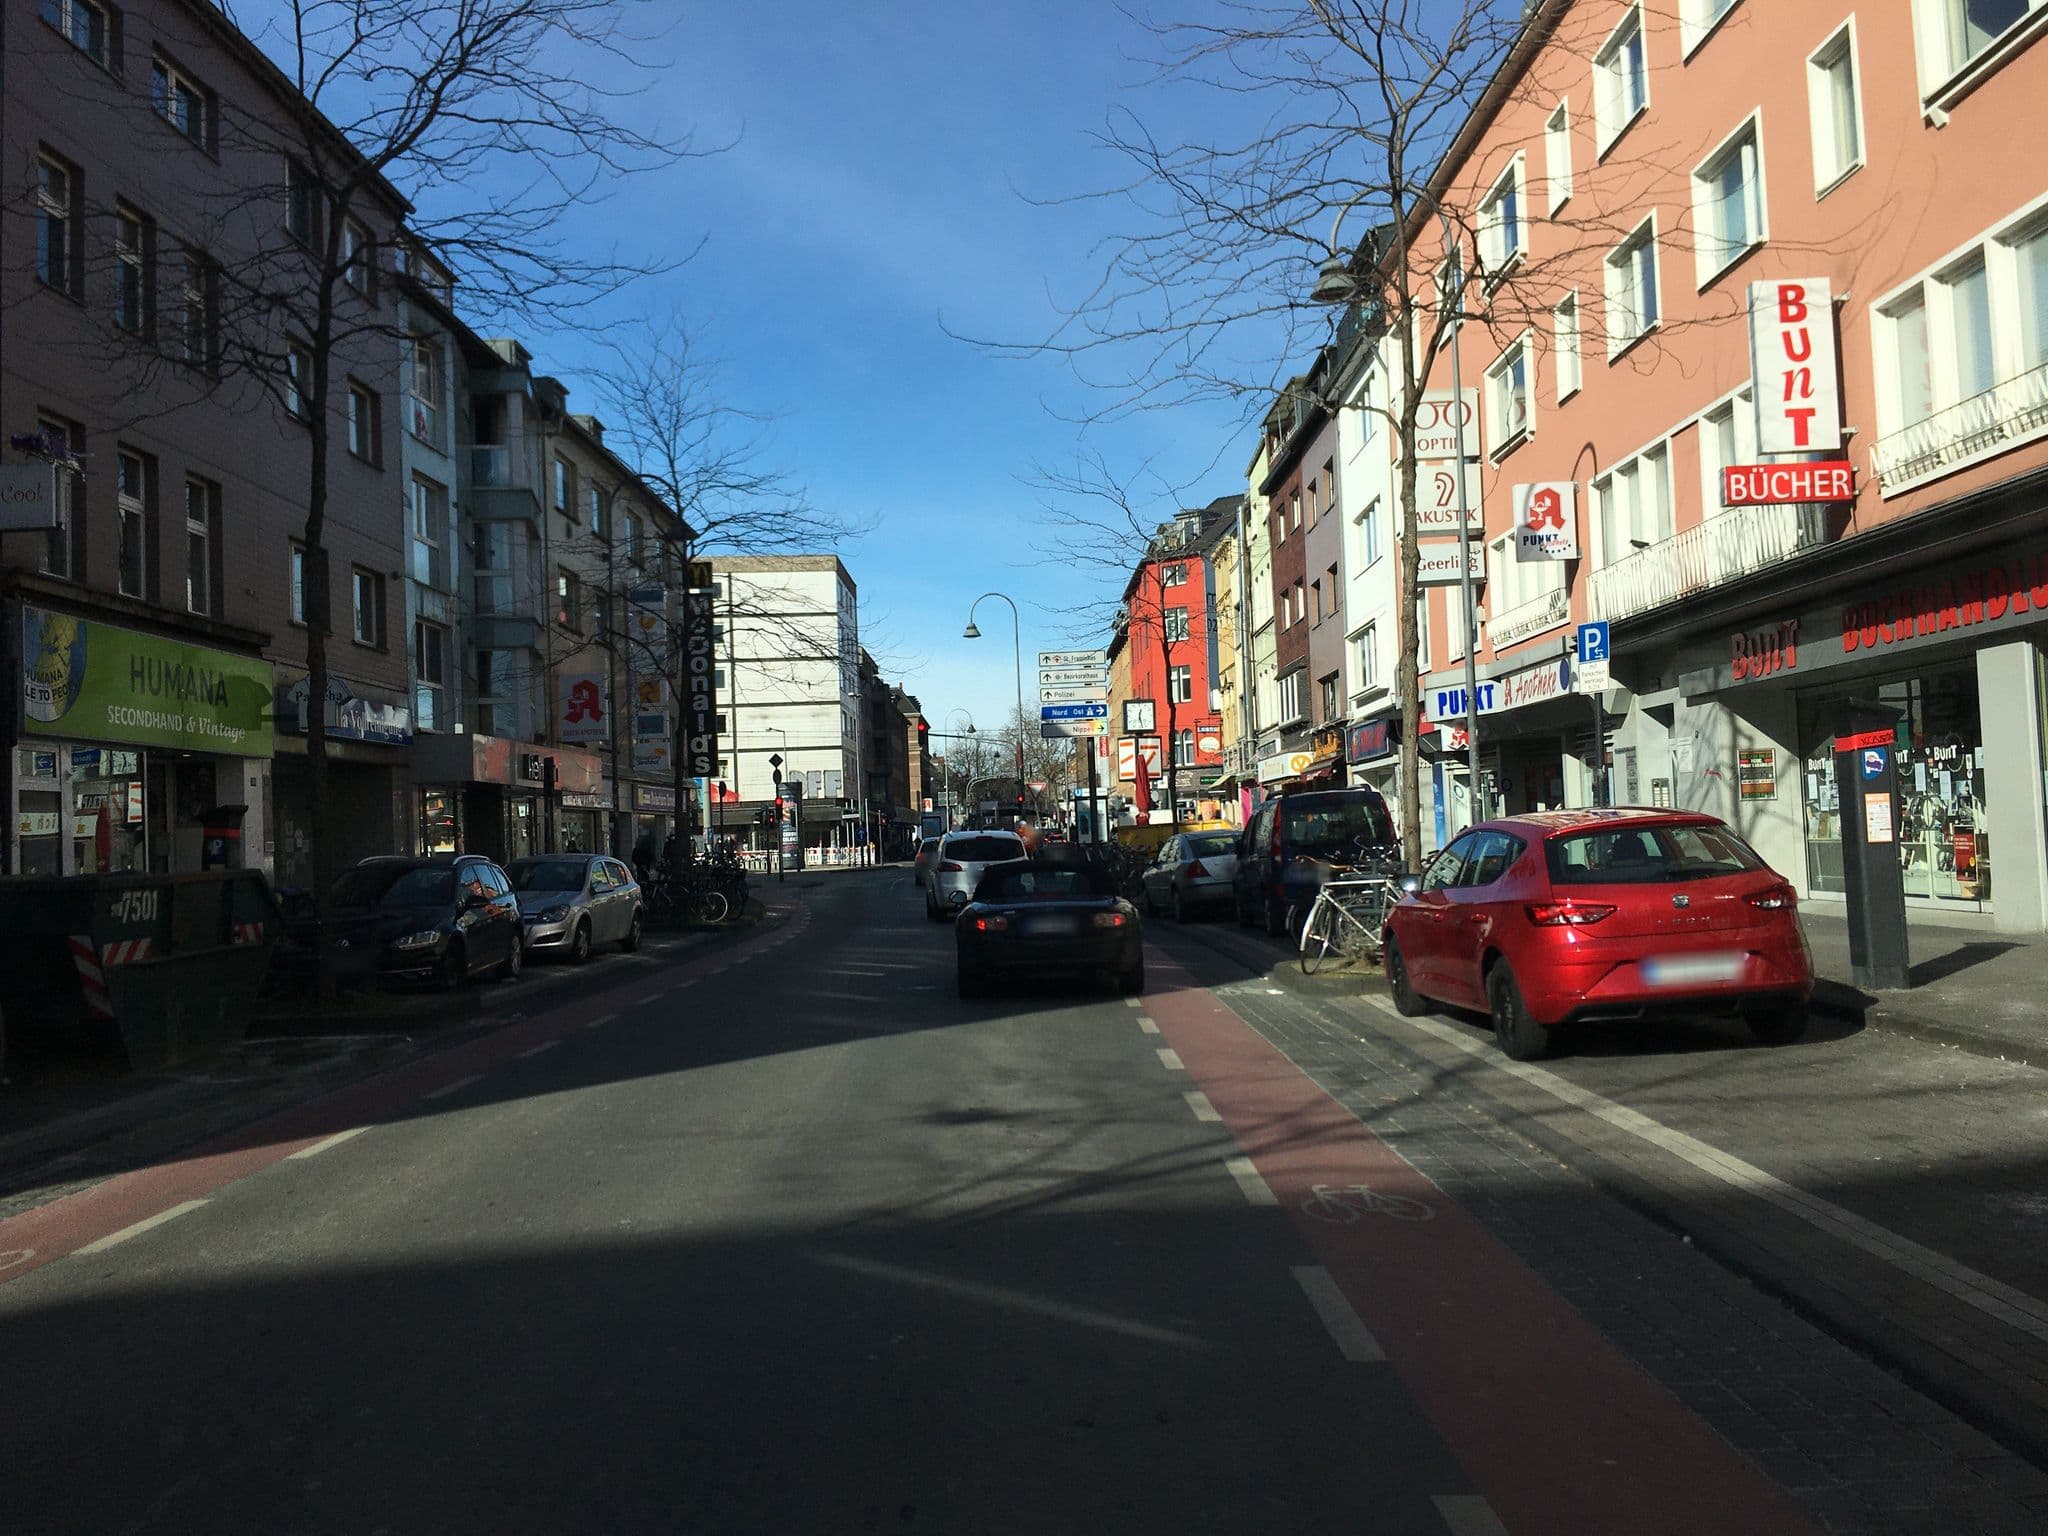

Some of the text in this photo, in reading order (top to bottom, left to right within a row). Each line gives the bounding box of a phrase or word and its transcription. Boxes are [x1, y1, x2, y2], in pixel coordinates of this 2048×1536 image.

[1417, 437, 1459, 451] OPTI
[1729, 467, 1851, 502] BÜCHER
[1415, 508, 1478, 525] AKUSTK
[1523, 533, 1559, 547] PUNKT
[1416, 554, 1479, 572] Geerlig
[130, 653, 229, 708] HUMANA
[1515, 663, 1557, 704] Apotheke
[107, 705, 246, 743] SECONDHAND & Vintage
